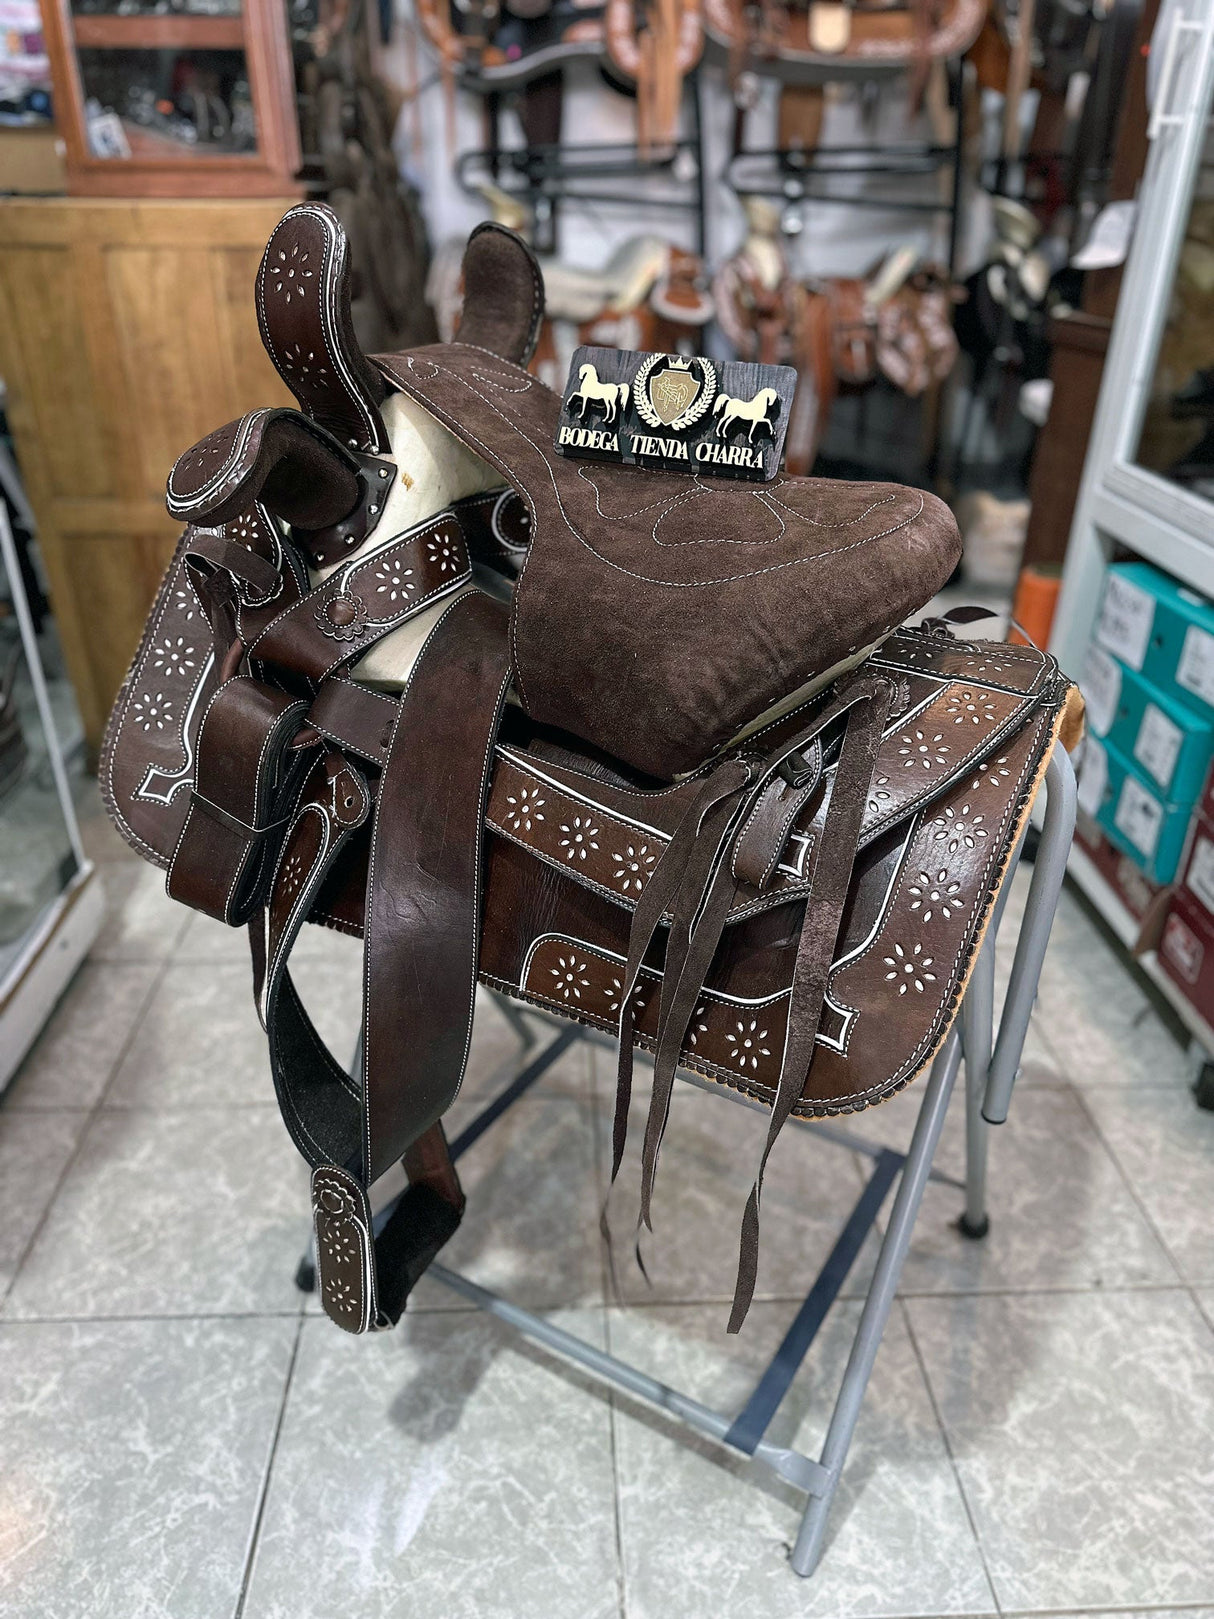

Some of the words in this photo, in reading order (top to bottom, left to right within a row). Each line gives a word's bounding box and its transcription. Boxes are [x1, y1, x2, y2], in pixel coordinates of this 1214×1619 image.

[559, 427, 619, 452] BODEGA
[630, 434, 689, 460] TIENDA
[695, 442, 764, 469] CHARRA
